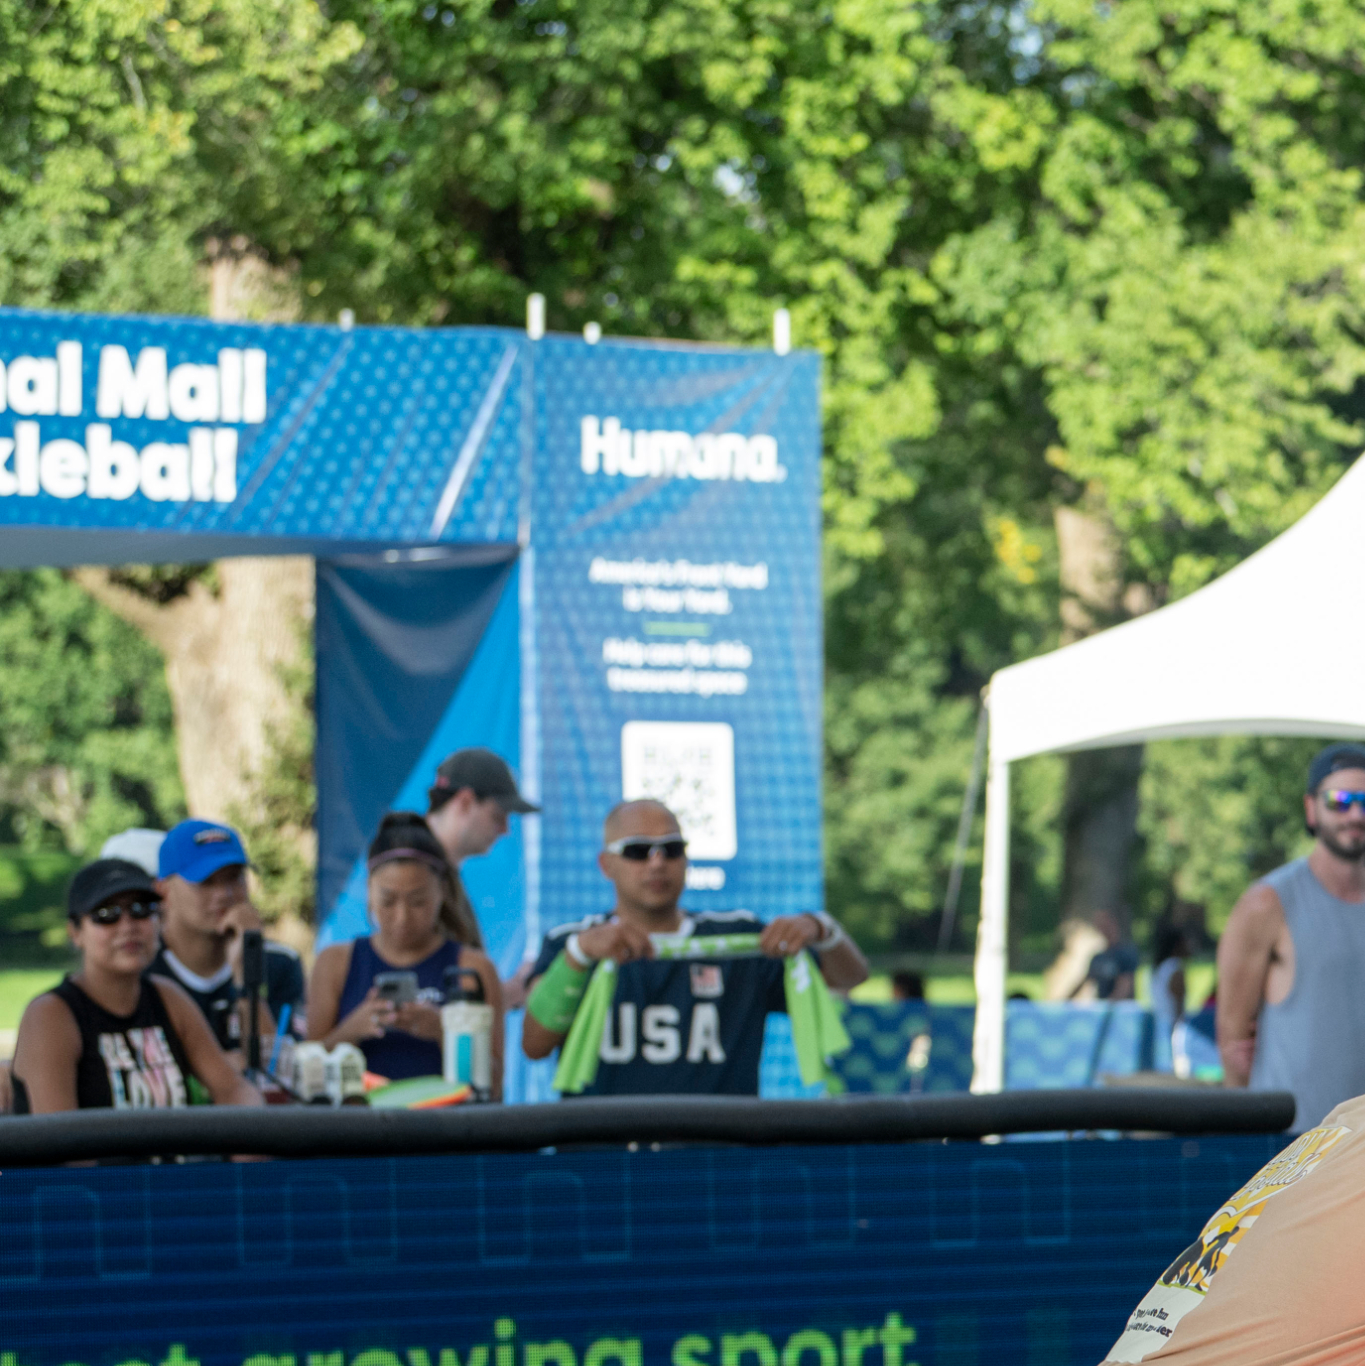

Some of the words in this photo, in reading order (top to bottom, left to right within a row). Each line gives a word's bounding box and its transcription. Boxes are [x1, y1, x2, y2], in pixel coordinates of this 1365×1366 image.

[0, 340, 83, 417] al
[95, 344, 267, 424] Mall
[599, 1003, 726, 1065] USA
